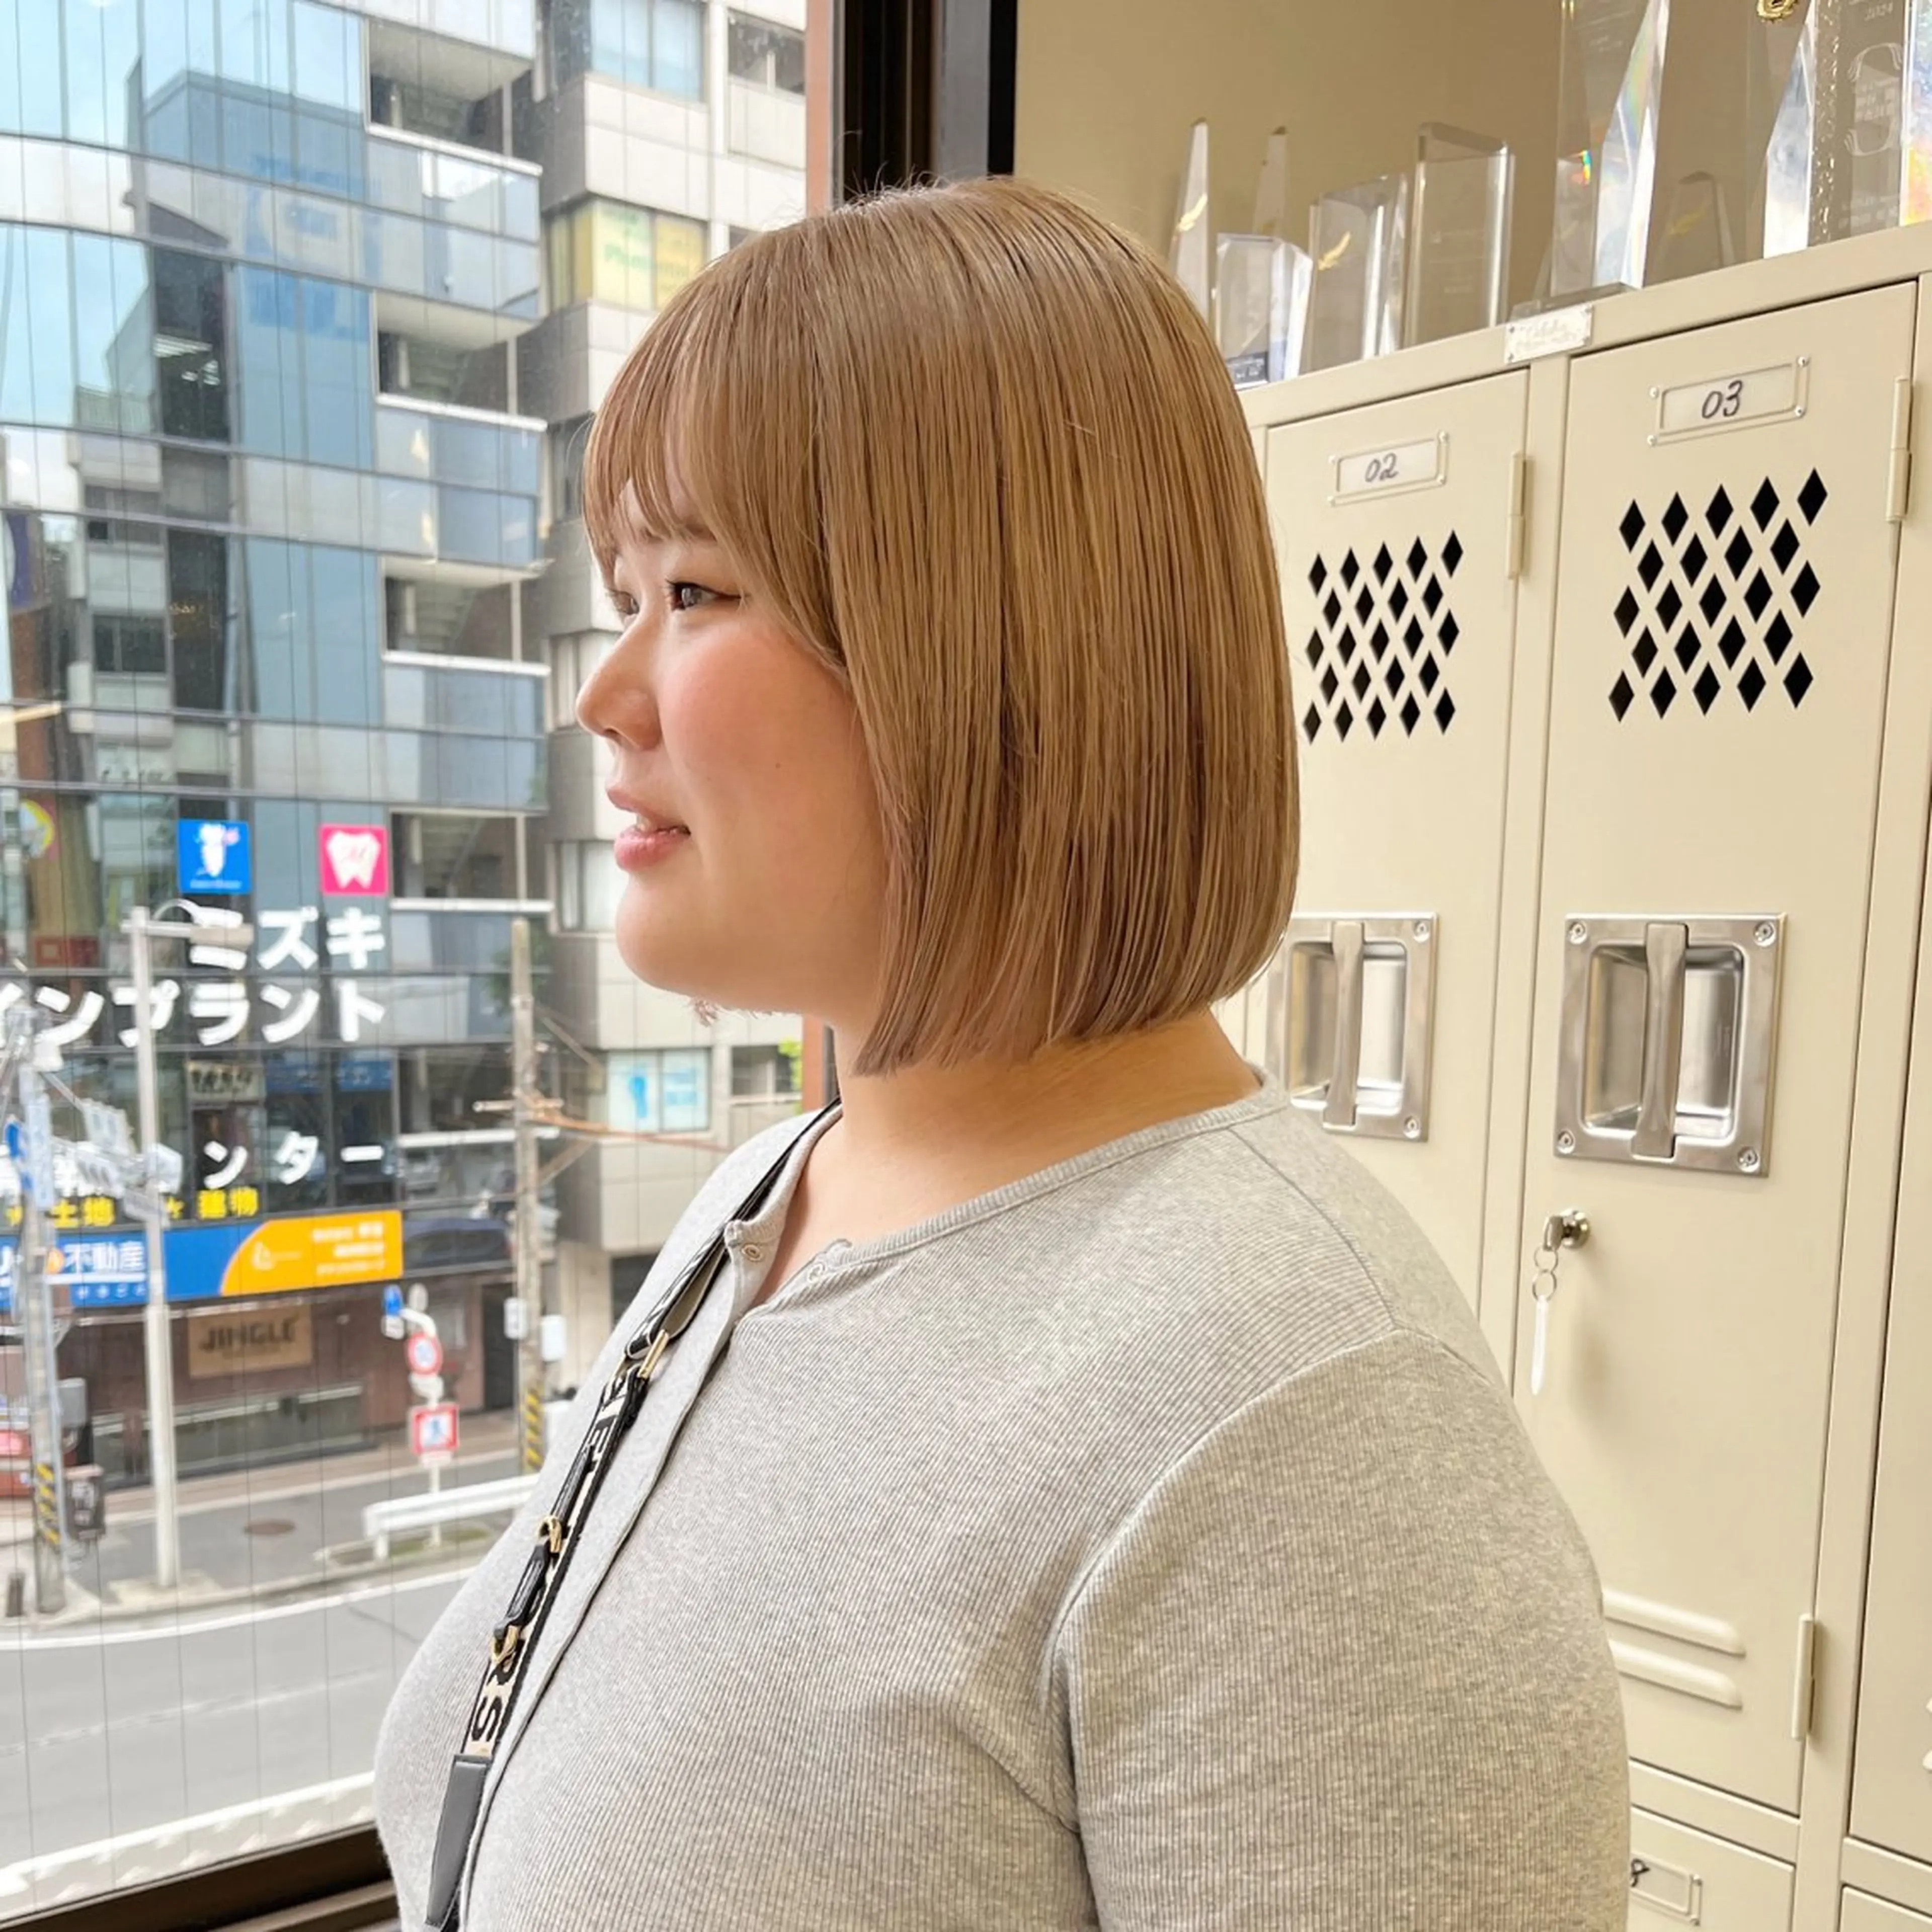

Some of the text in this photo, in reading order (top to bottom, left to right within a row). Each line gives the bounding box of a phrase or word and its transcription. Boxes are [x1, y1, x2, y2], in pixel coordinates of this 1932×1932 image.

[1702, 379, 1743, 419] 03
[1365, 453, 1399, 482] 02
[189, 907, 386, 971] ミズキ
[0, 979, 386, 1049] ンプラント
[205, 1131, 384, 1188] ンター
